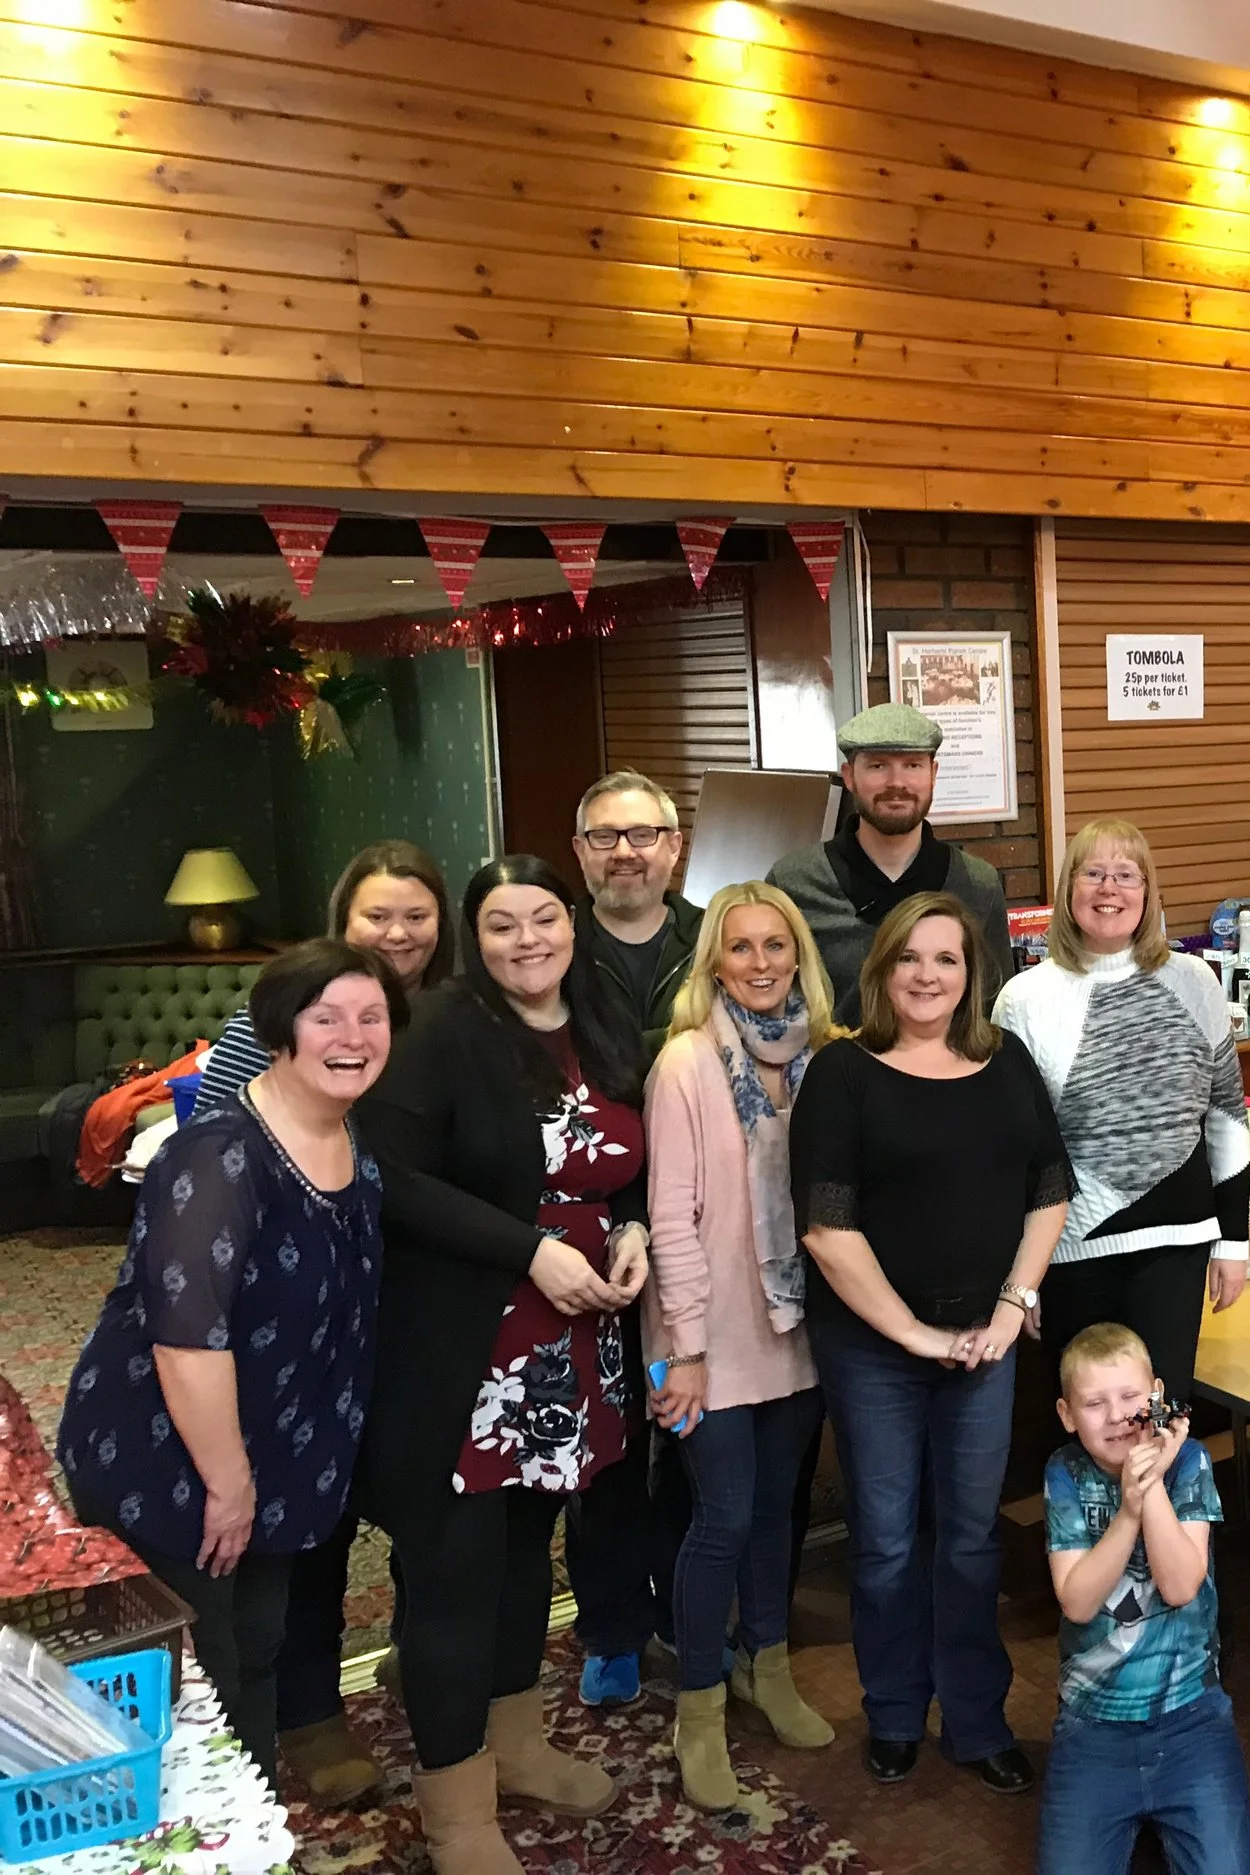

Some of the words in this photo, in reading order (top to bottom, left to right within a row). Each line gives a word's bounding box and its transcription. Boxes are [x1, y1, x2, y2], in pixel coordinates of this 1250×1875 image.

[1126, 650, 1185, 665] TOMBOLA
[1125, 671, 1142, 685] 25p
[1144, 673, 1158, 685] per
[1123, 685, 1129, 697] 5
[1131, 685, 1161, 697] tickets
[1163, 685, 1175, 696] for
[1177, 685, 1188, 696] £1
